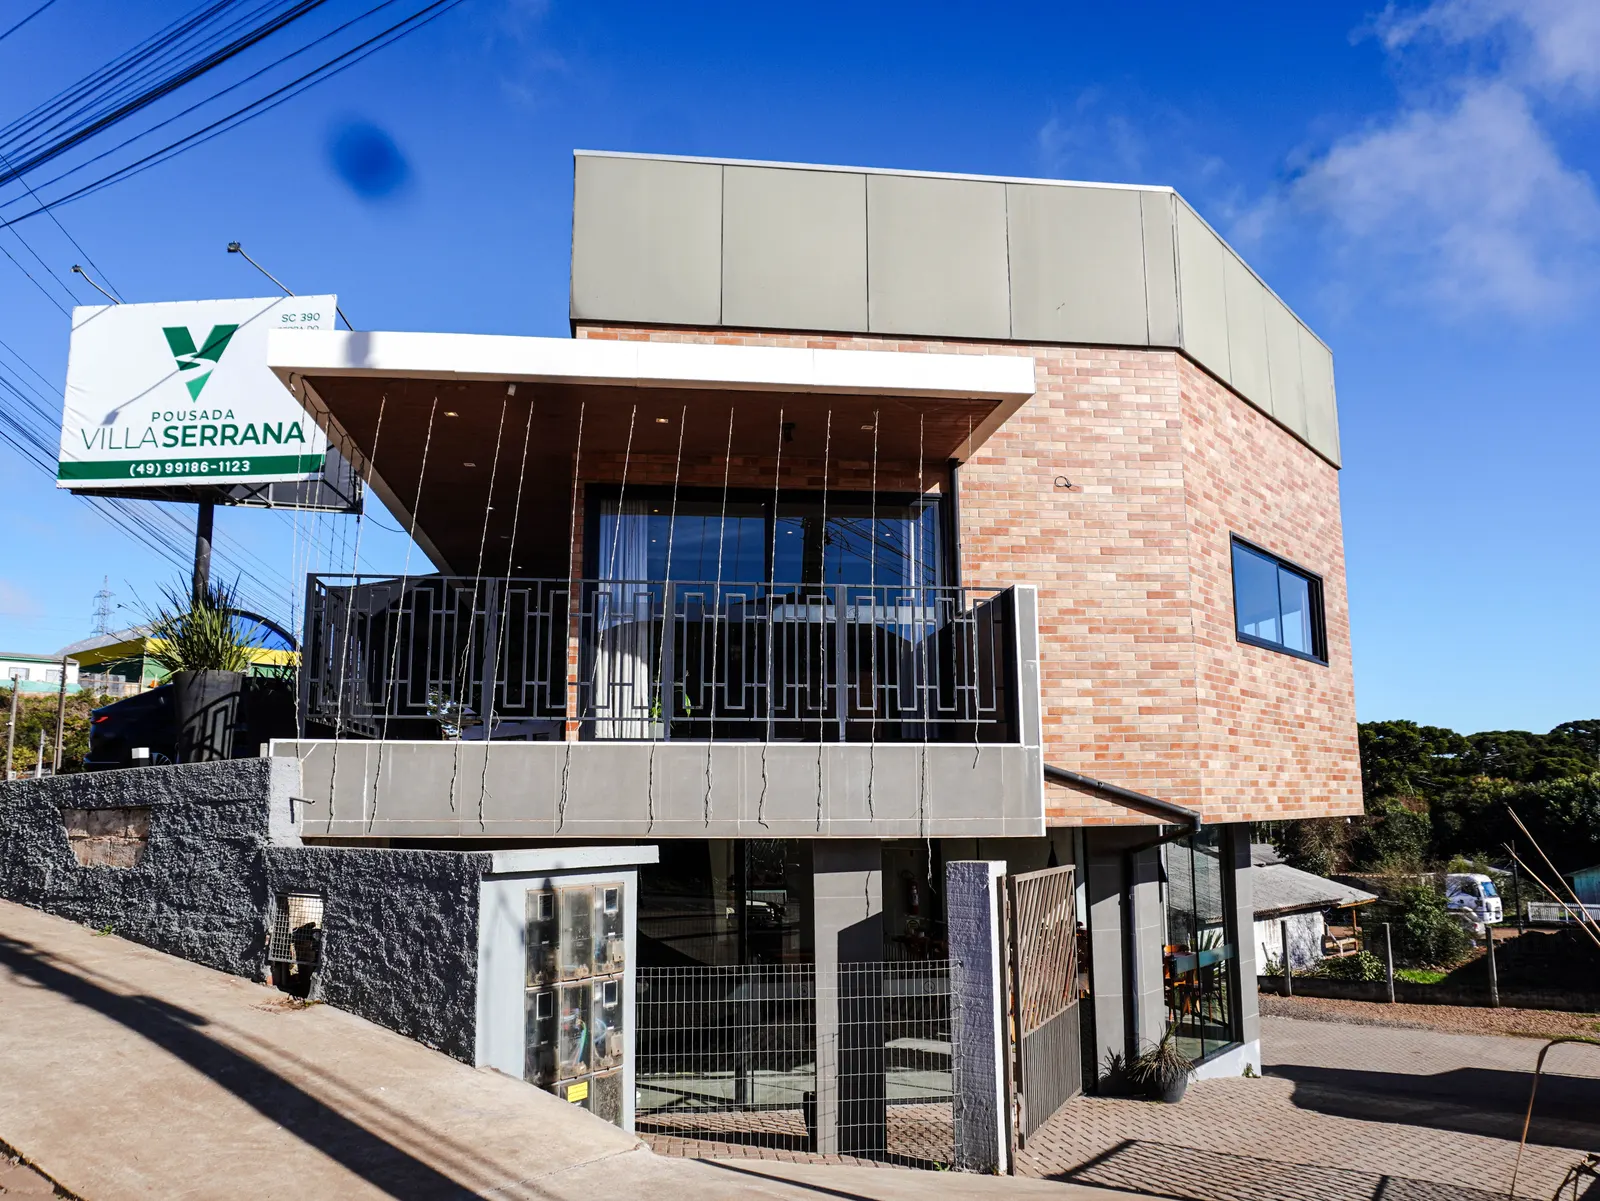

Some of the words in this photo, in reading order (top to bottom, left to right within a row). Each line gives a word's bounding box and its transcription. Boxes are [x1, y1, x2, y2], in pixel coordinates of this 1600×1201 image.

[281, 313, 296, 323] SC
[300, 312, 321, 322] 390
[151, 409, 235, 423] POUSADA
[80, 426, 158, 450] VILLA
[162, 421, 306, 448] SERRANA
[129, 462, 161, 477] (49)
[165, 460, 251, 475] 99186-1123
